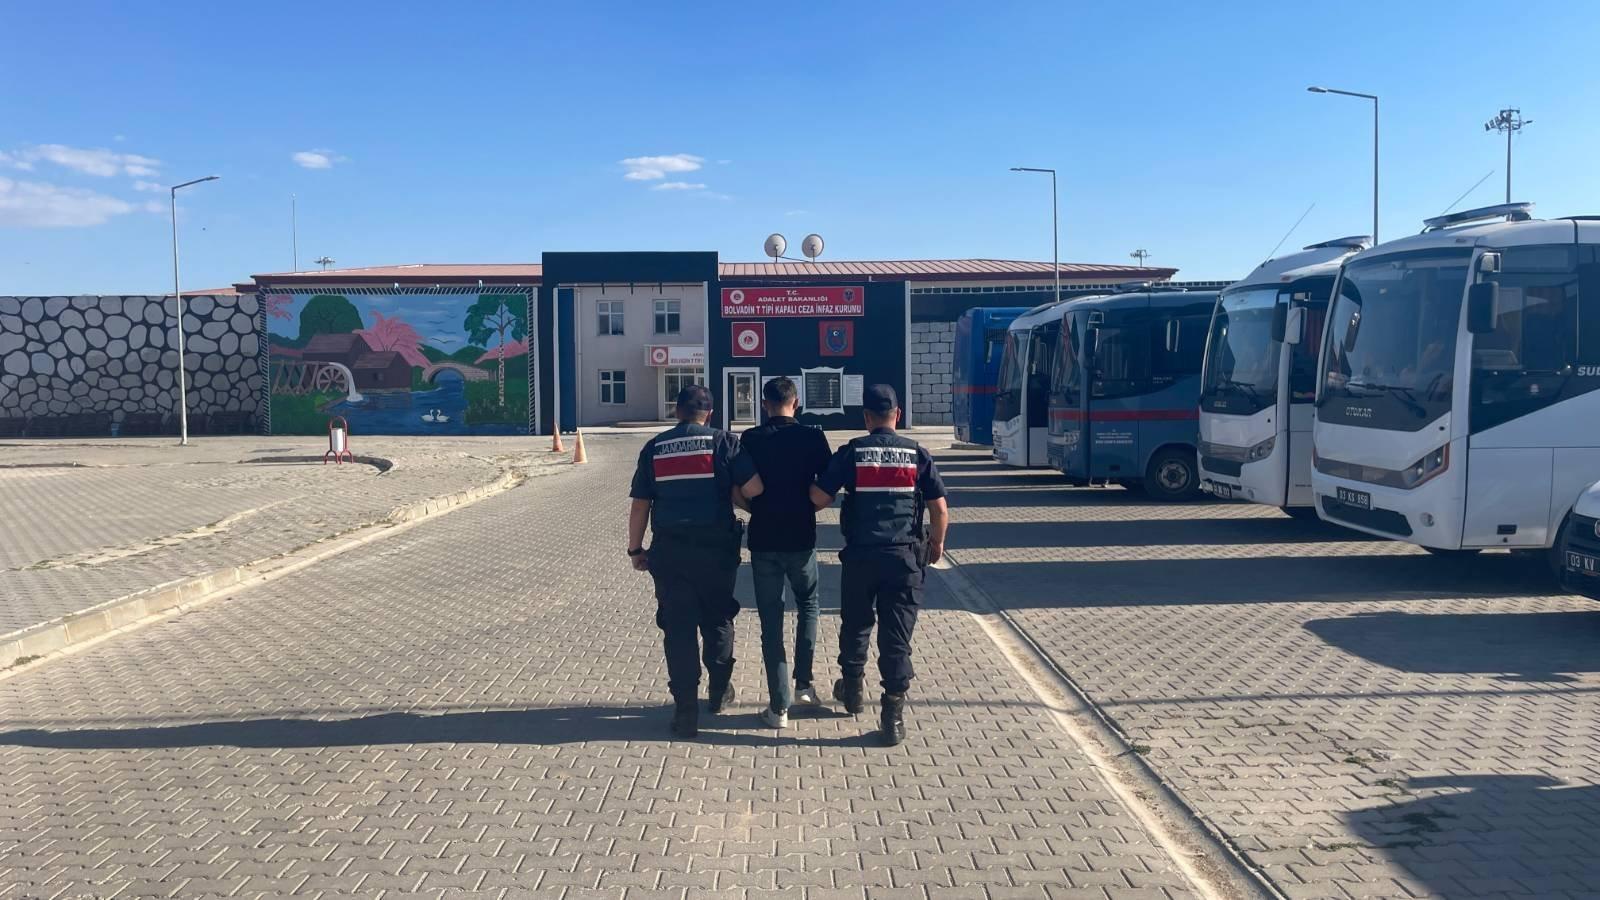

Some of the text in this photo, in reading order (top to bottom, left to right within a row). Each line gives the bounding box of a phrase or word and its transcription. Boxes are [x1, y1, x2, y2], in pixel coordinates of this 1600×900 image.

[724, 303, 862, 315] BOLVADİN T TİPİ KAPALI CEZA İNFAZ KURUMU
[1345, 406, 1373, 418] OTOKAR
[658, 439, 708, 455] JANDARMA
[861, 450, 912, 465] JANDARMA
[1570, 554, 1581, 568] 03
